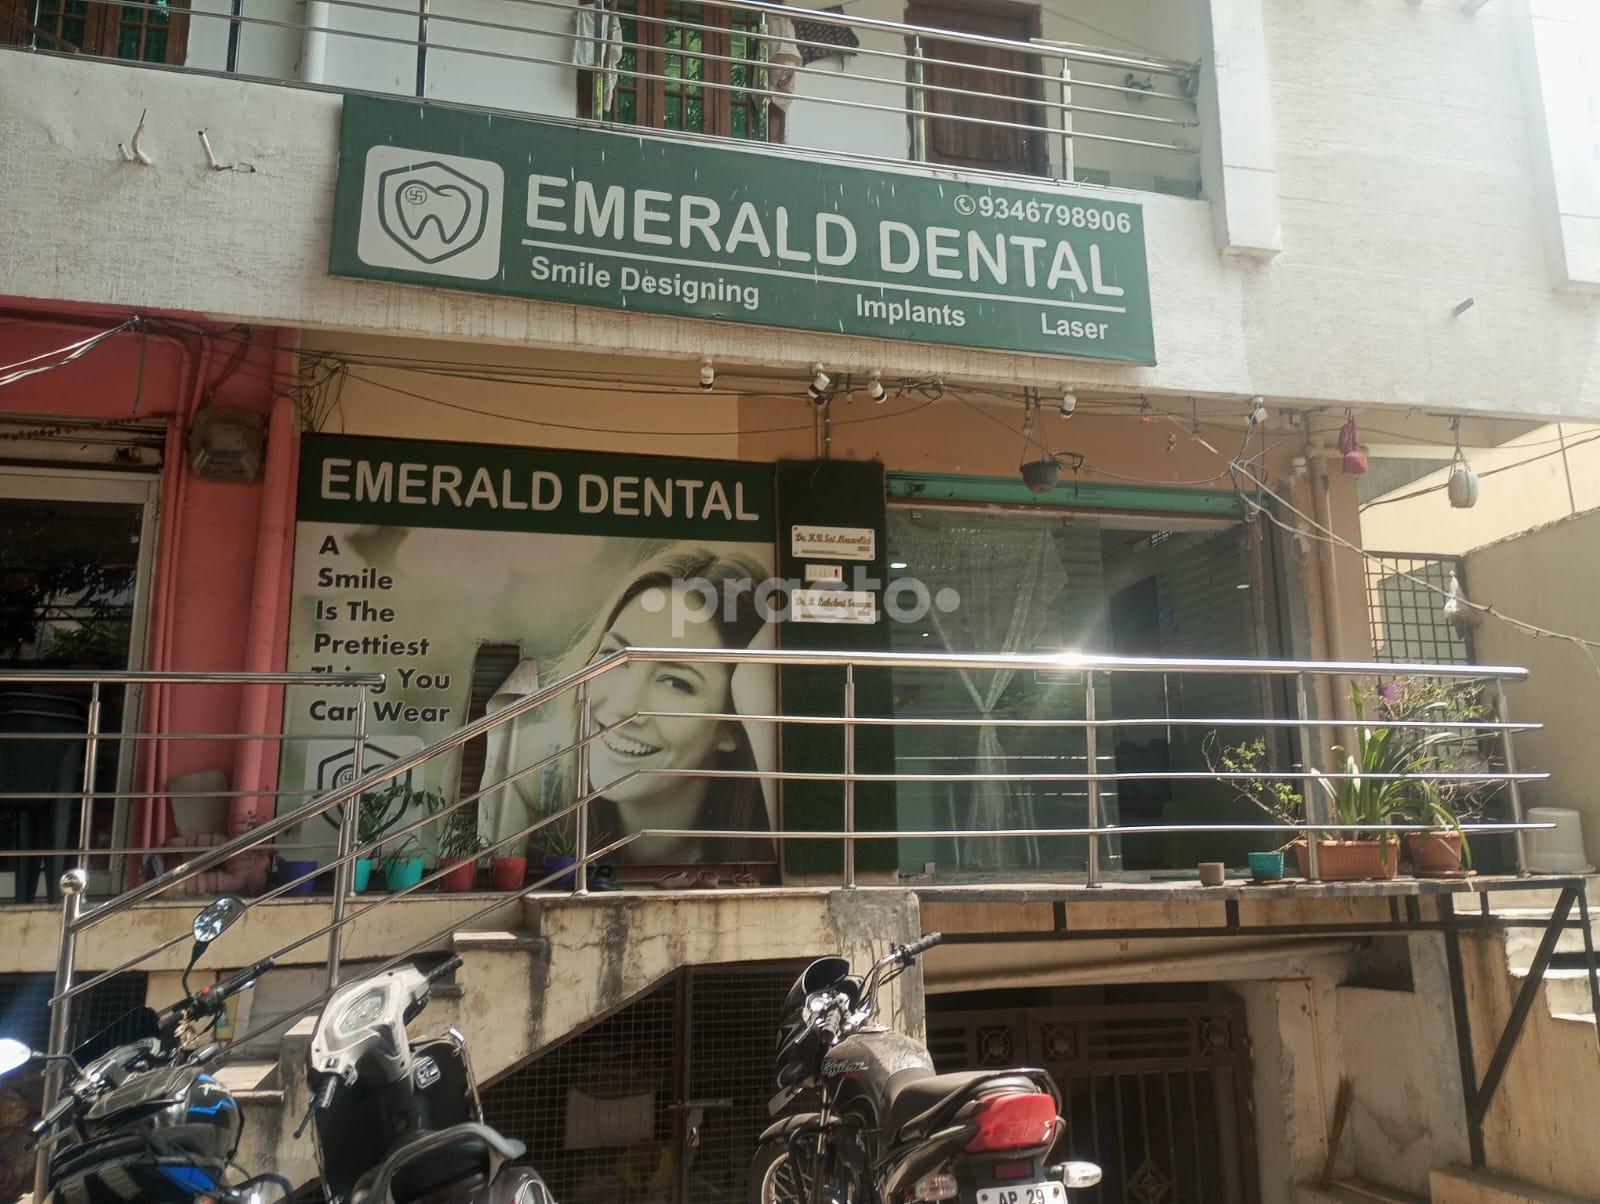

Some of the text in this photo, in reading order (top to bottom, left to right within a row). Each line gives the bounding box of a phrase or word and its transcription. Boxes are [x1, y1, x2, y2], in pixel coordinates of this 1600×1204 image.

[979, 195, 1131, 234] 9346798906
[526, 173, 1125, 297] EMERALD DENTAL
[530, 256, 760, 310] Smile Designing
[856, 293, 966, 327] Implants
[1040, 313, 1109, 340] Laser
[320, 457, 760, 521] EMERALD DENTAL
[319, 535, 340, 555] A
[317, 567, 393, 590] Smile
[316, 600, 395, 623] Is The
[314, 633, 430, 656] Prettiest
[397, 668, 450, 690] You
[373, 701, 451, 722] Wear
